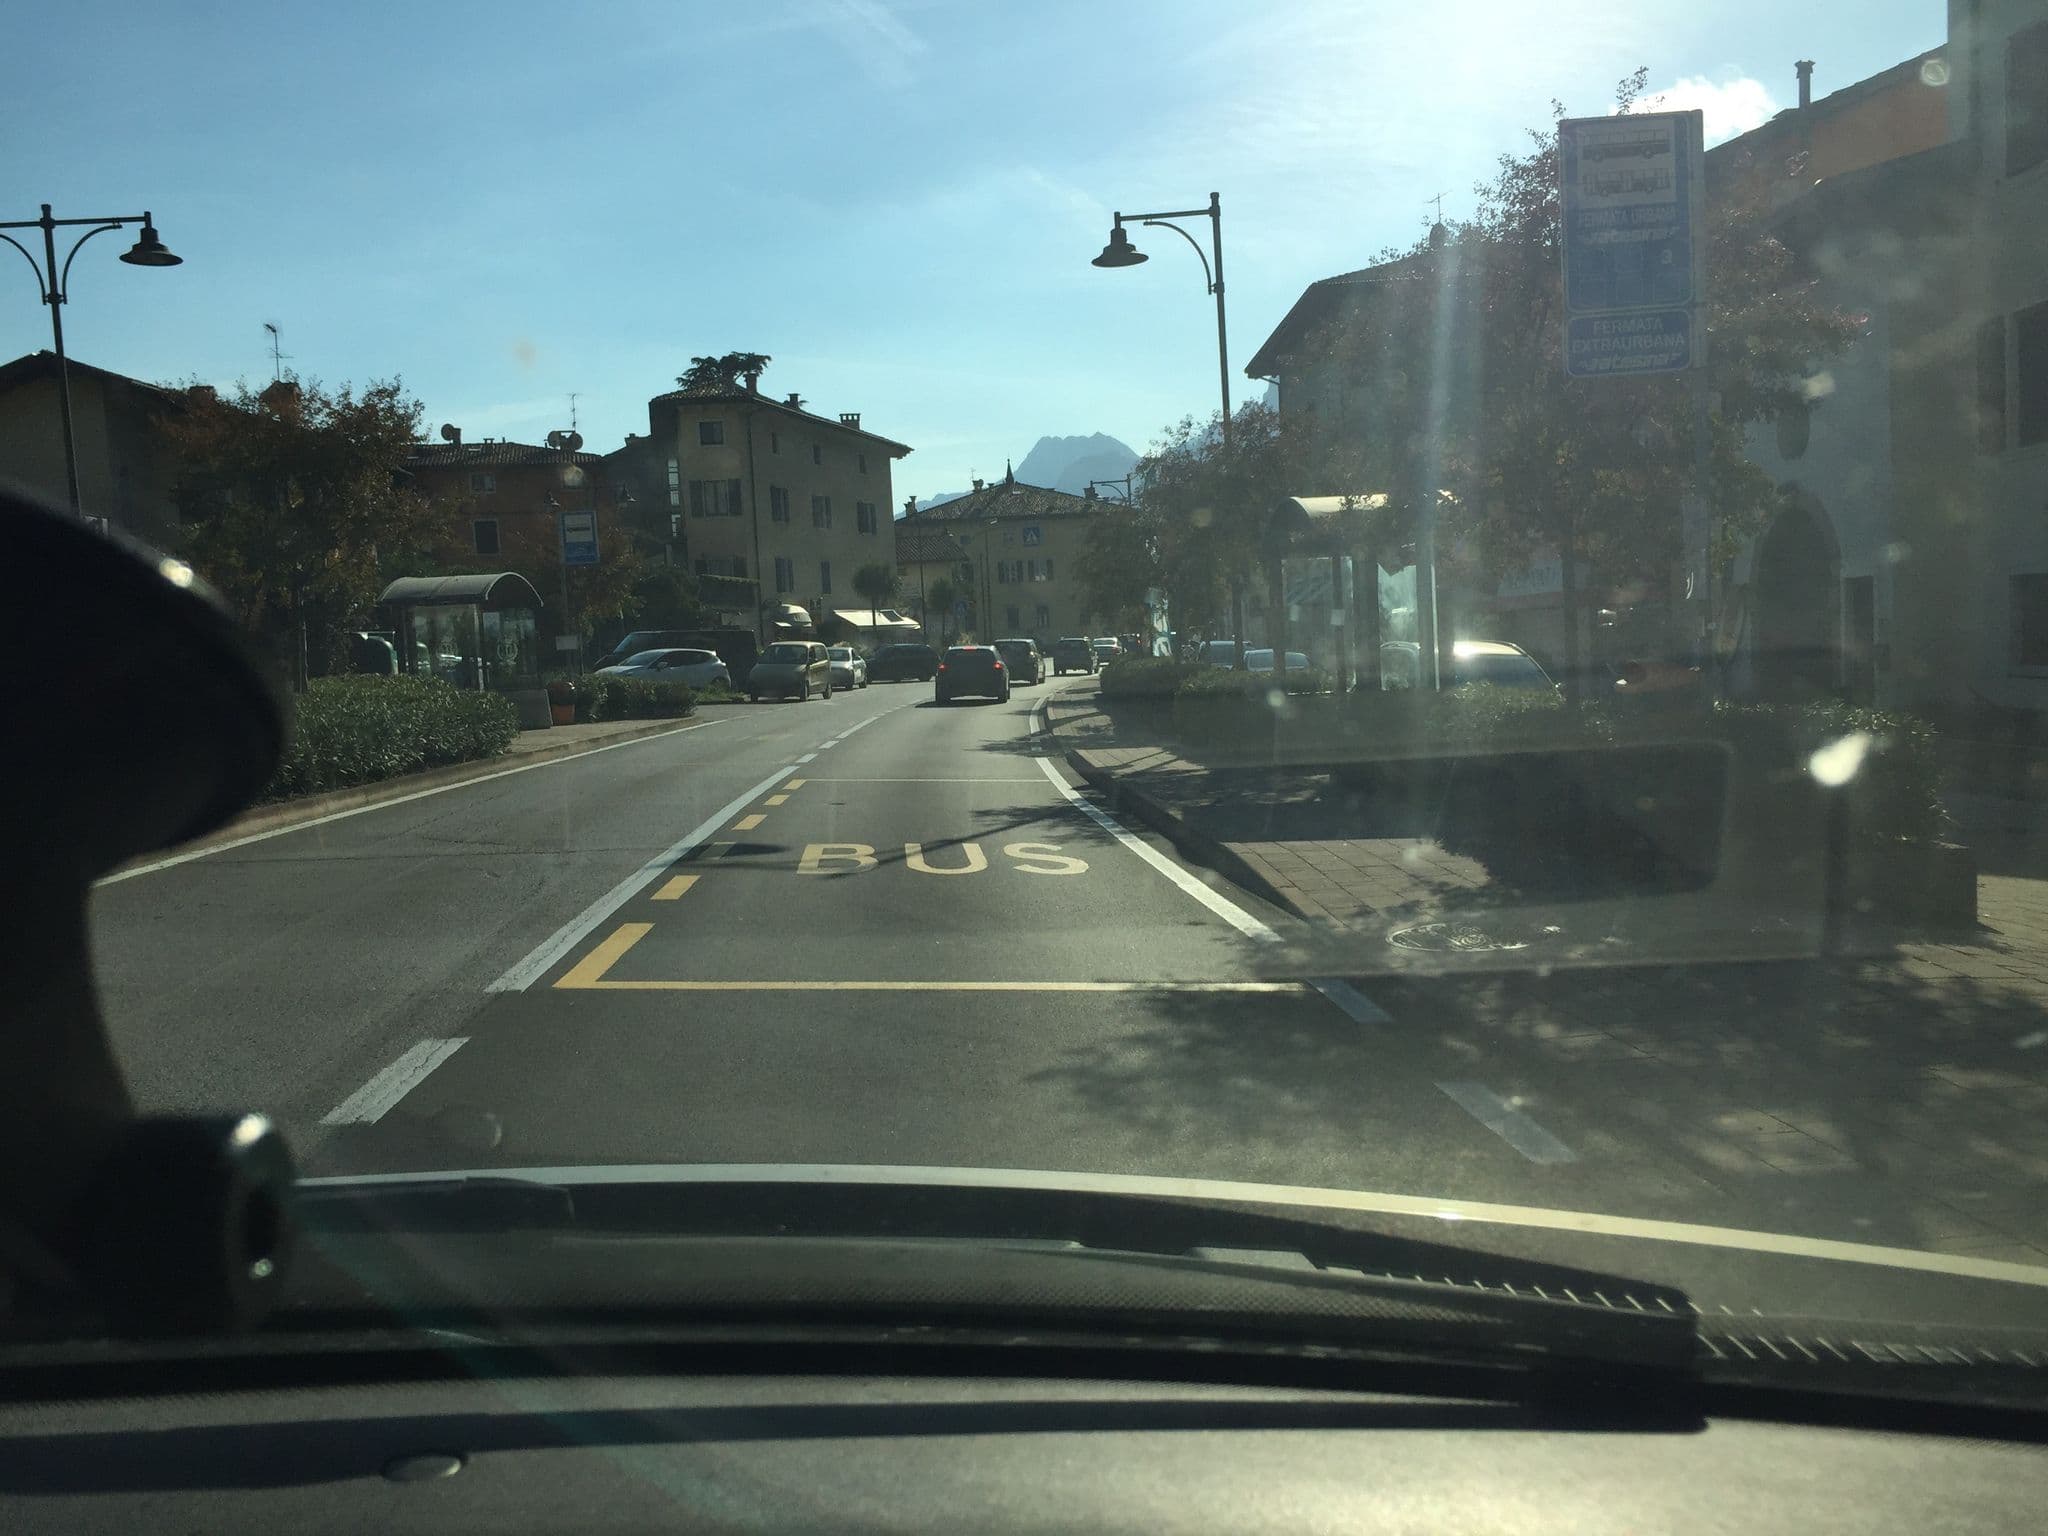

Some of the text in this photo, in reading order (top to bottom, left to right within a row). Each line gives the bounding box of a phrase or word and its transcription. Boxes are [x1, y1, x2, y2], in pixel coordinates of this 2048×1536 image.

[1593, 316, 1664, 335] FERMATA
[1572, 332, 1685, 353] EXTRAURBANA
[796, 842, 1089, 876] BUS
